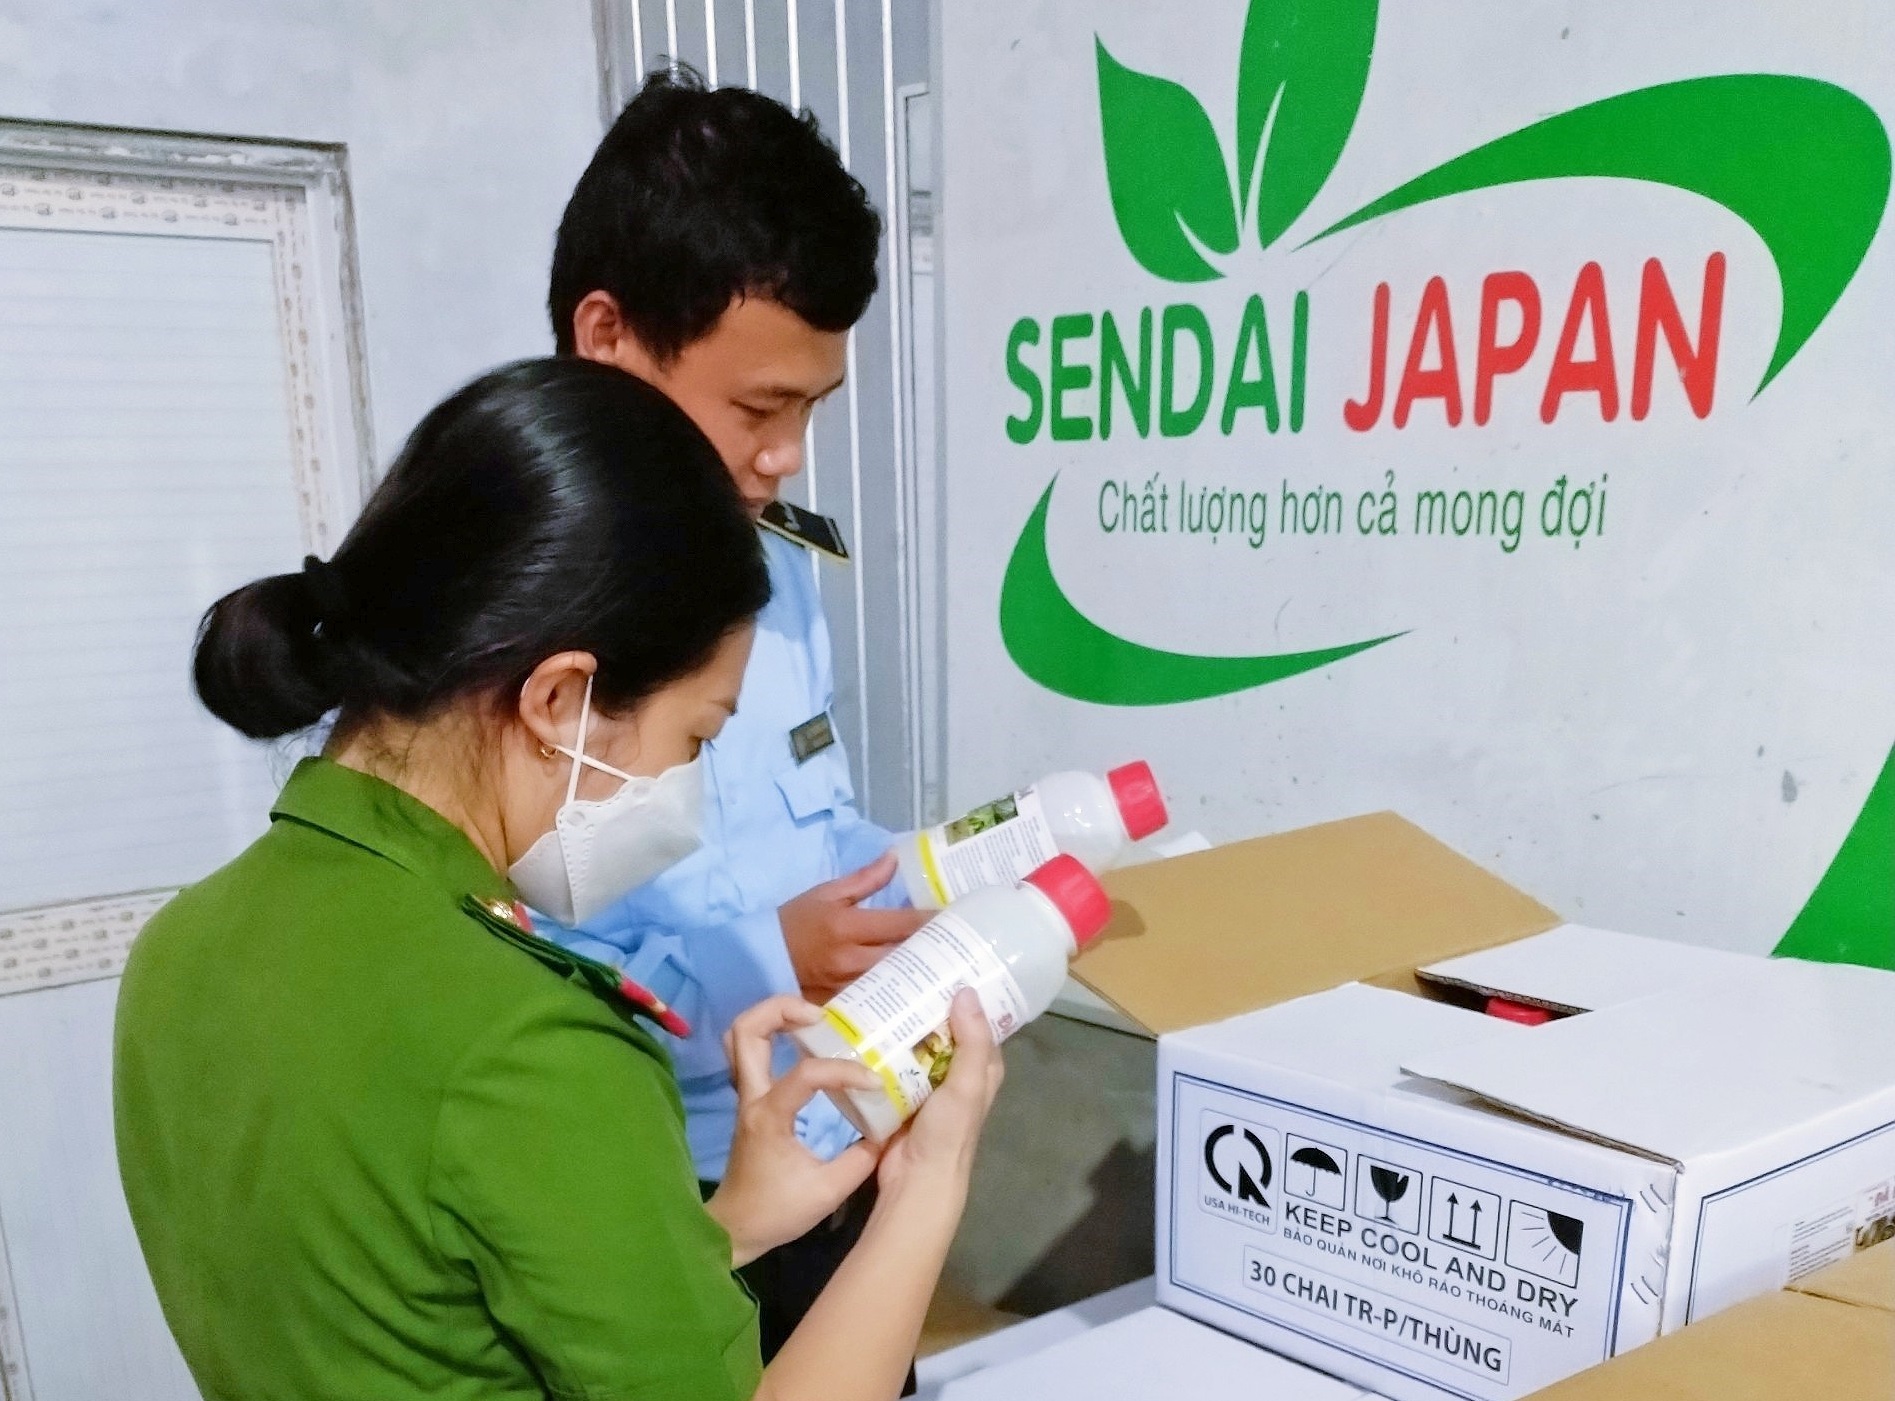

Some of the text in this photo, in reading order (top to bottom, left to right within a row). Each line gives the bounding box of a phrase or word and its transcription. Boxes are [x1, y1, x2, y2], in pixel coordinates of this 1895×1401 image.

[1004, 250, 1727, 445] SENDAI JAPAN
[1099, 469, 1608, 553] Chất lượng hơn cả mong đợi
[1204, 1195, 1270, 1226] USA HI-TECH
[1285, 1201, 1579, 1318] KEEP COOL AND DRY
[1250, 1260, 1502, 1373] 30 CHAI TR-P/THÙNG
[1361, 1254, 1387, 1272] NƠI
[1391, 1264, 1424, 1284] KHÔ
[1467, 1290, 1534, 1324] THOÁNG
[1539, 1316, 1575, 1338] MÁT
